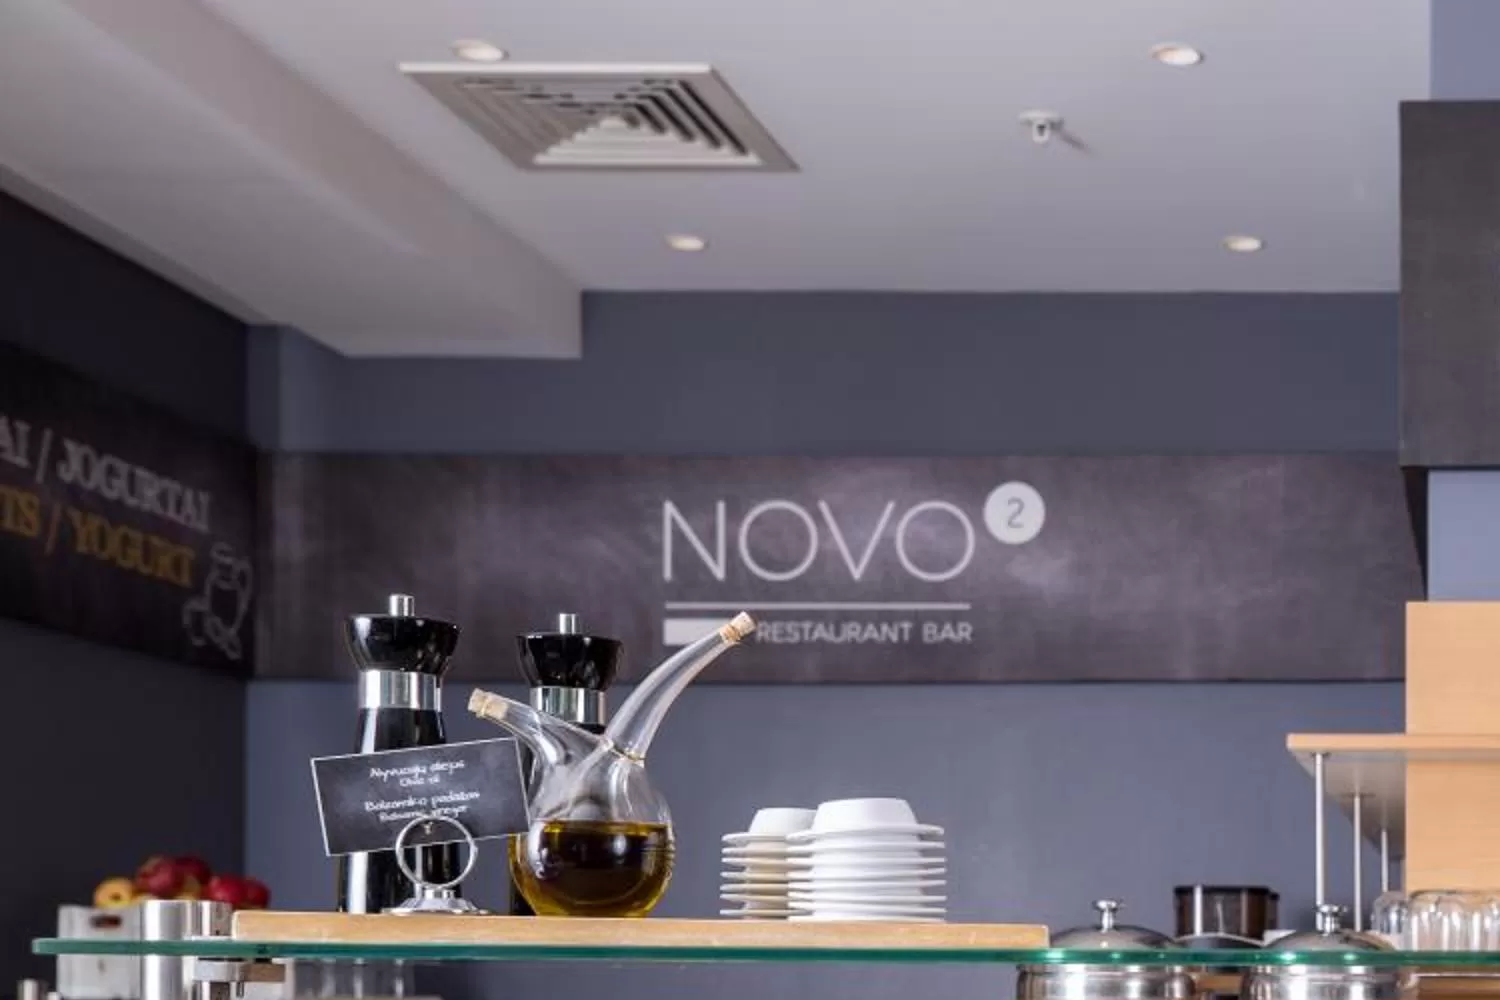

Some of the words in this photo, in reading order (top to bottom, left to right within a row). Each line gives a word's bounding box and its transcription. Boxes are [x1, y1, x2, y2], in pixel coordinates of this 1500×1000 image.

[58, 438, 210, 533] JOGURTAI
[68, 508, 194, 587] YOGURT
[663, 499, 975, 582] NOVO
[756, 620, 913, 644] RESTAURANT
[922, 620, 974, 644] BAR
